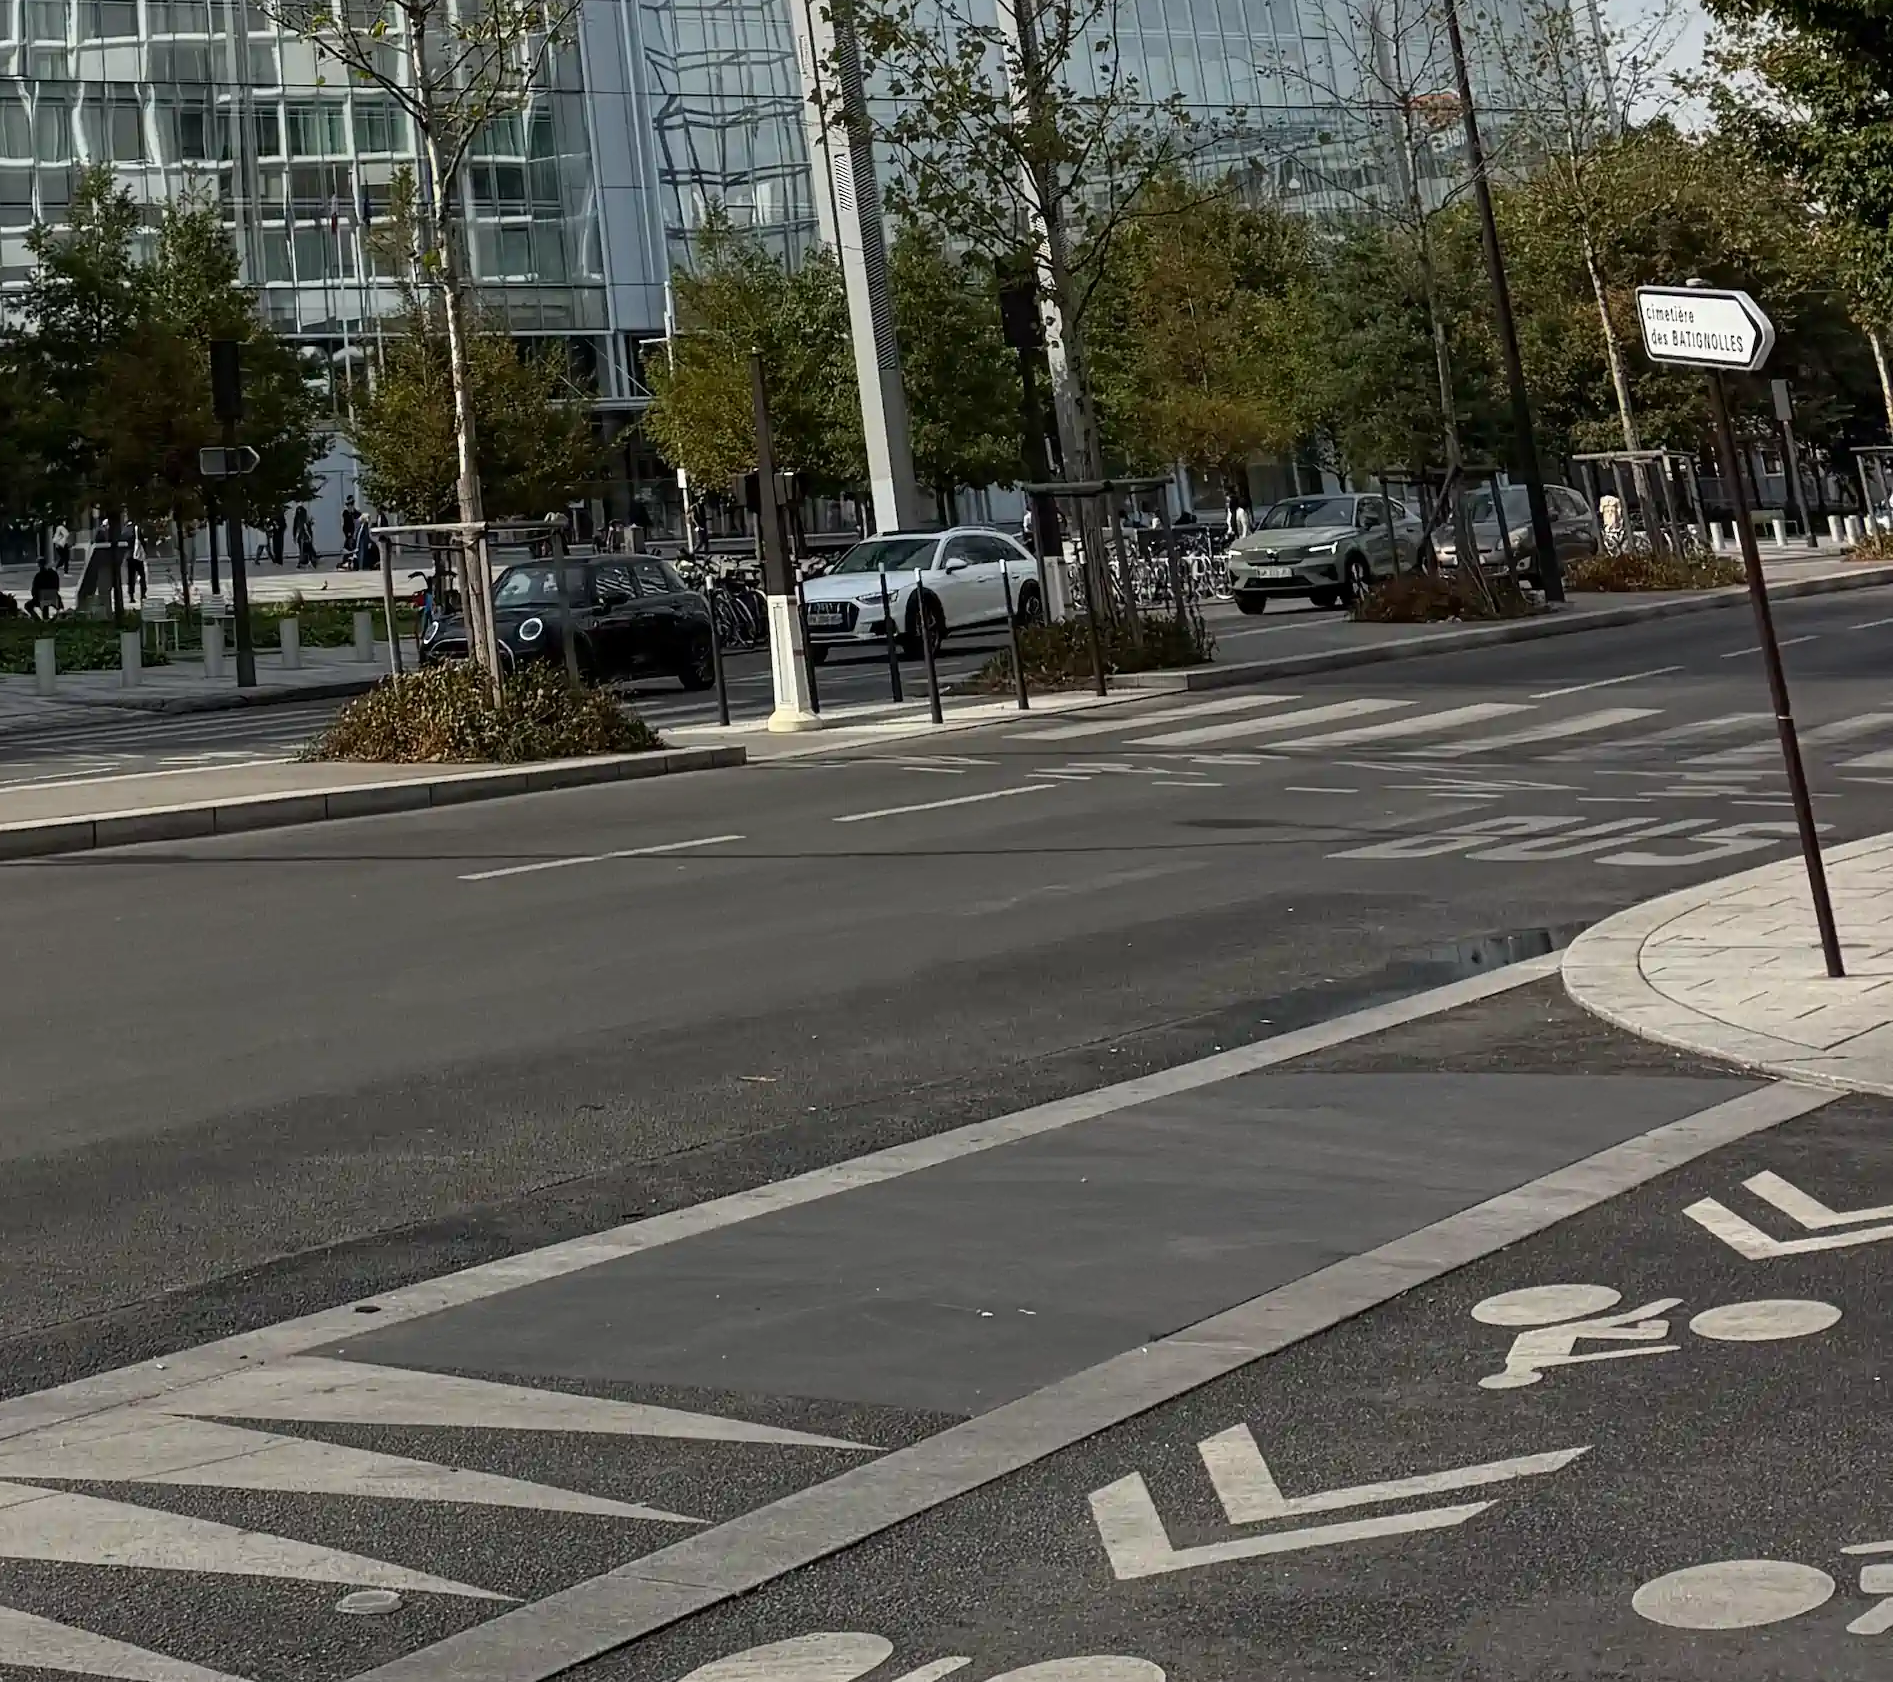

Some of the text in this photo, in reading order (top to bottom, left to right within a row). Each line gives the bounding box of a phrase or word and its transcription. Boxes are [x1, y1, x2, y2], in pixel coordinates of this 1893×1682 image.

[1646, 303, 1695, 323] cimetière
[1651, 328, 1745, 353] des BATIGNOLLES
[1322, 815, 1837, 867] BUS
